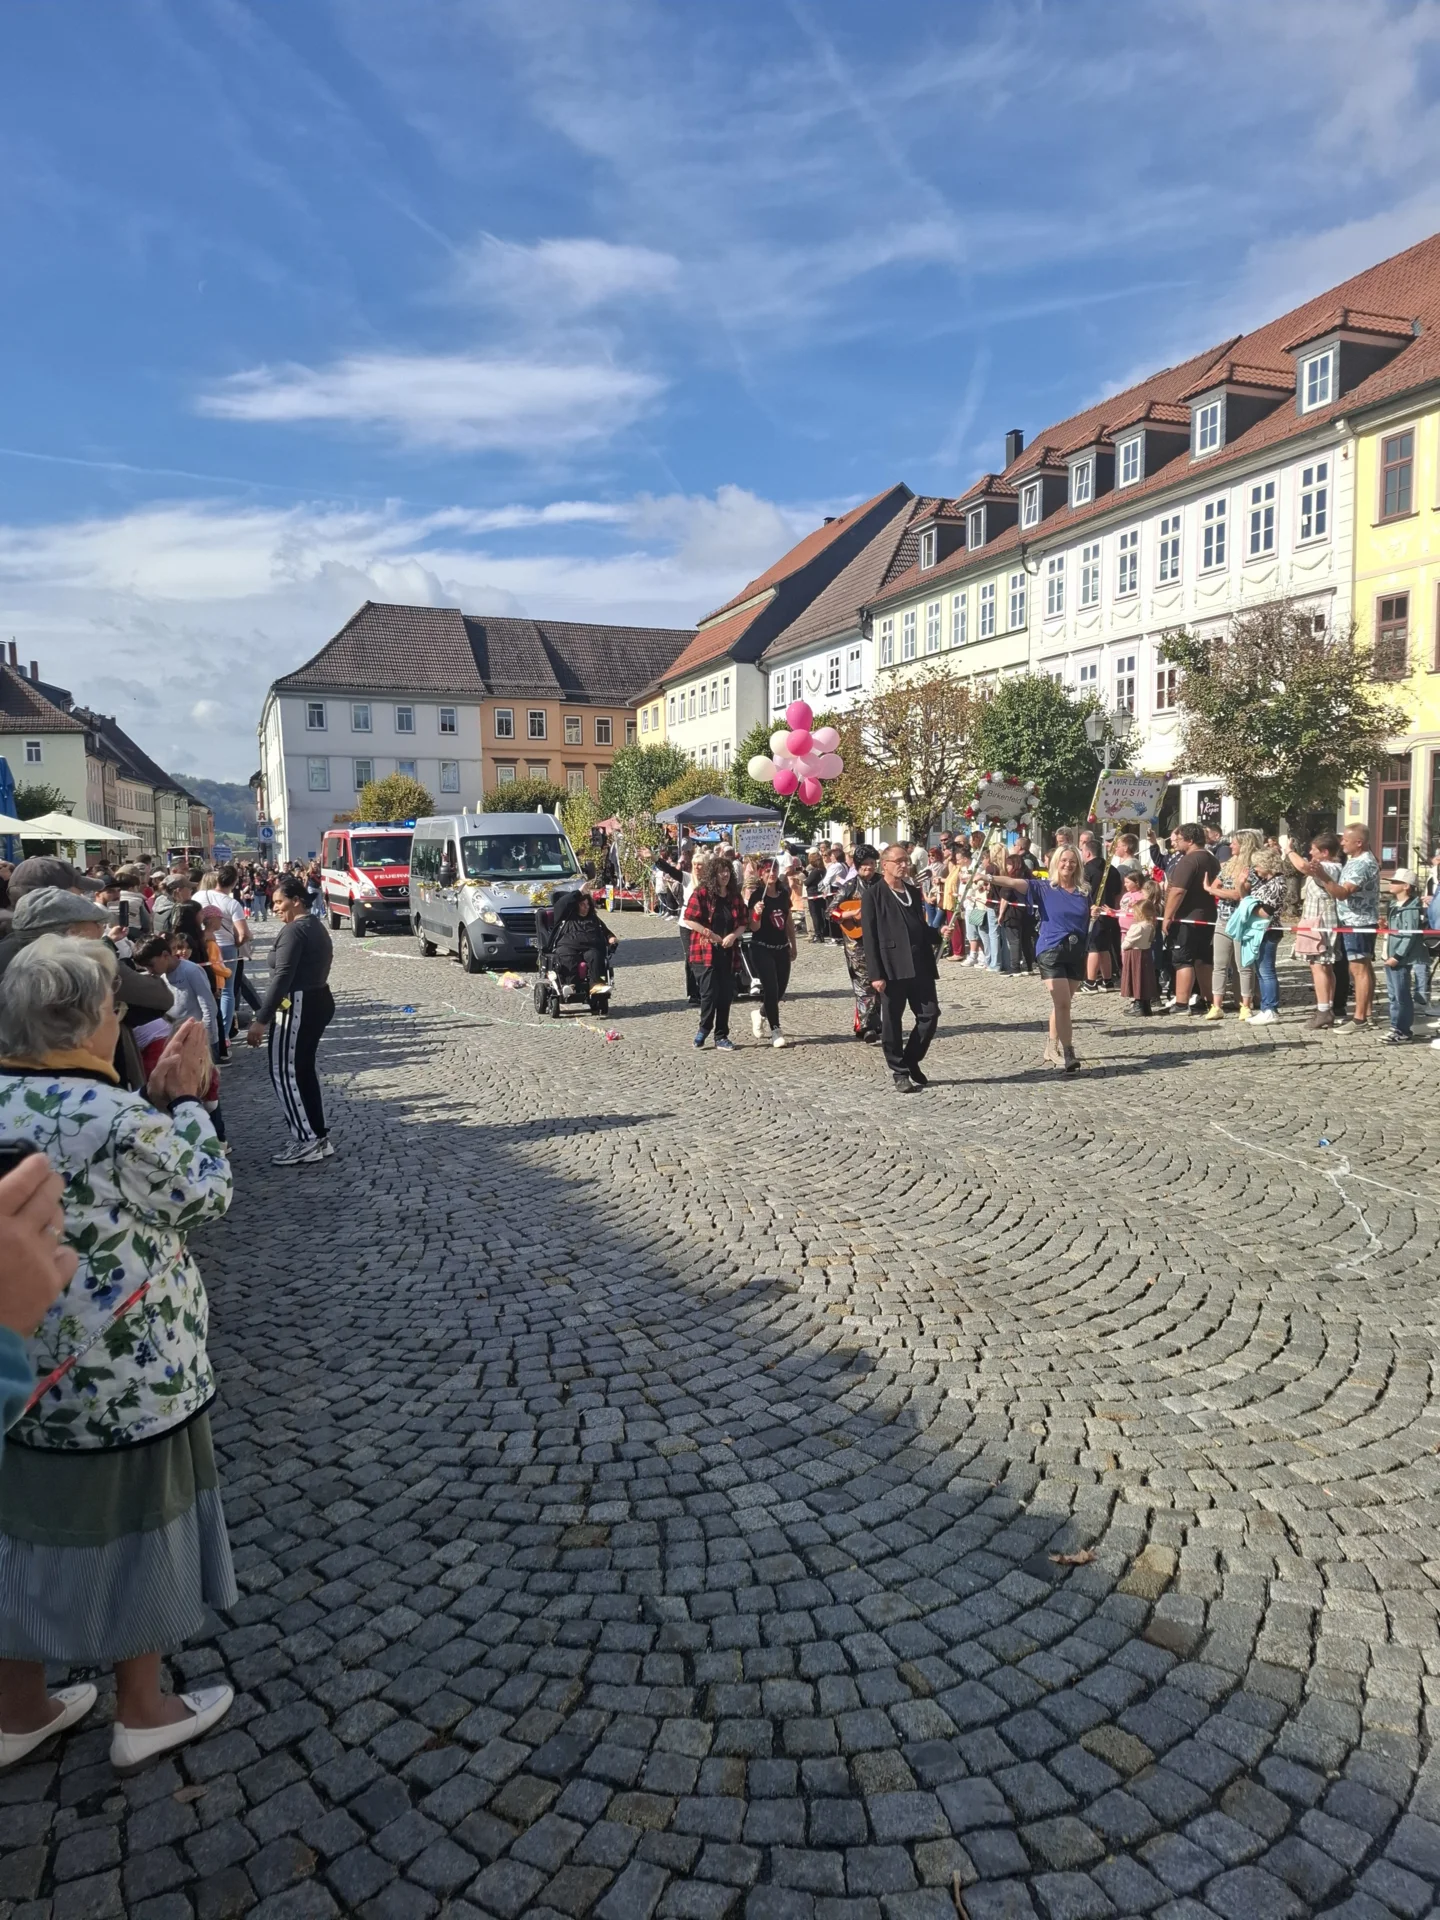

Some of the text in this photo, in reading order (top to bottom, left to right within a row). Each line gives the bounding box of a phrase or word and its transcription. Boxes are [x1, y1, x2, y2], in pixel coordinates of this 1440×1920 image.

[1113, 778, 1154, 787] WIR LEBEN
[987, 789, 1022, 805] Birkenfeld
[1112, 788, 1149, 797] MUSIK
